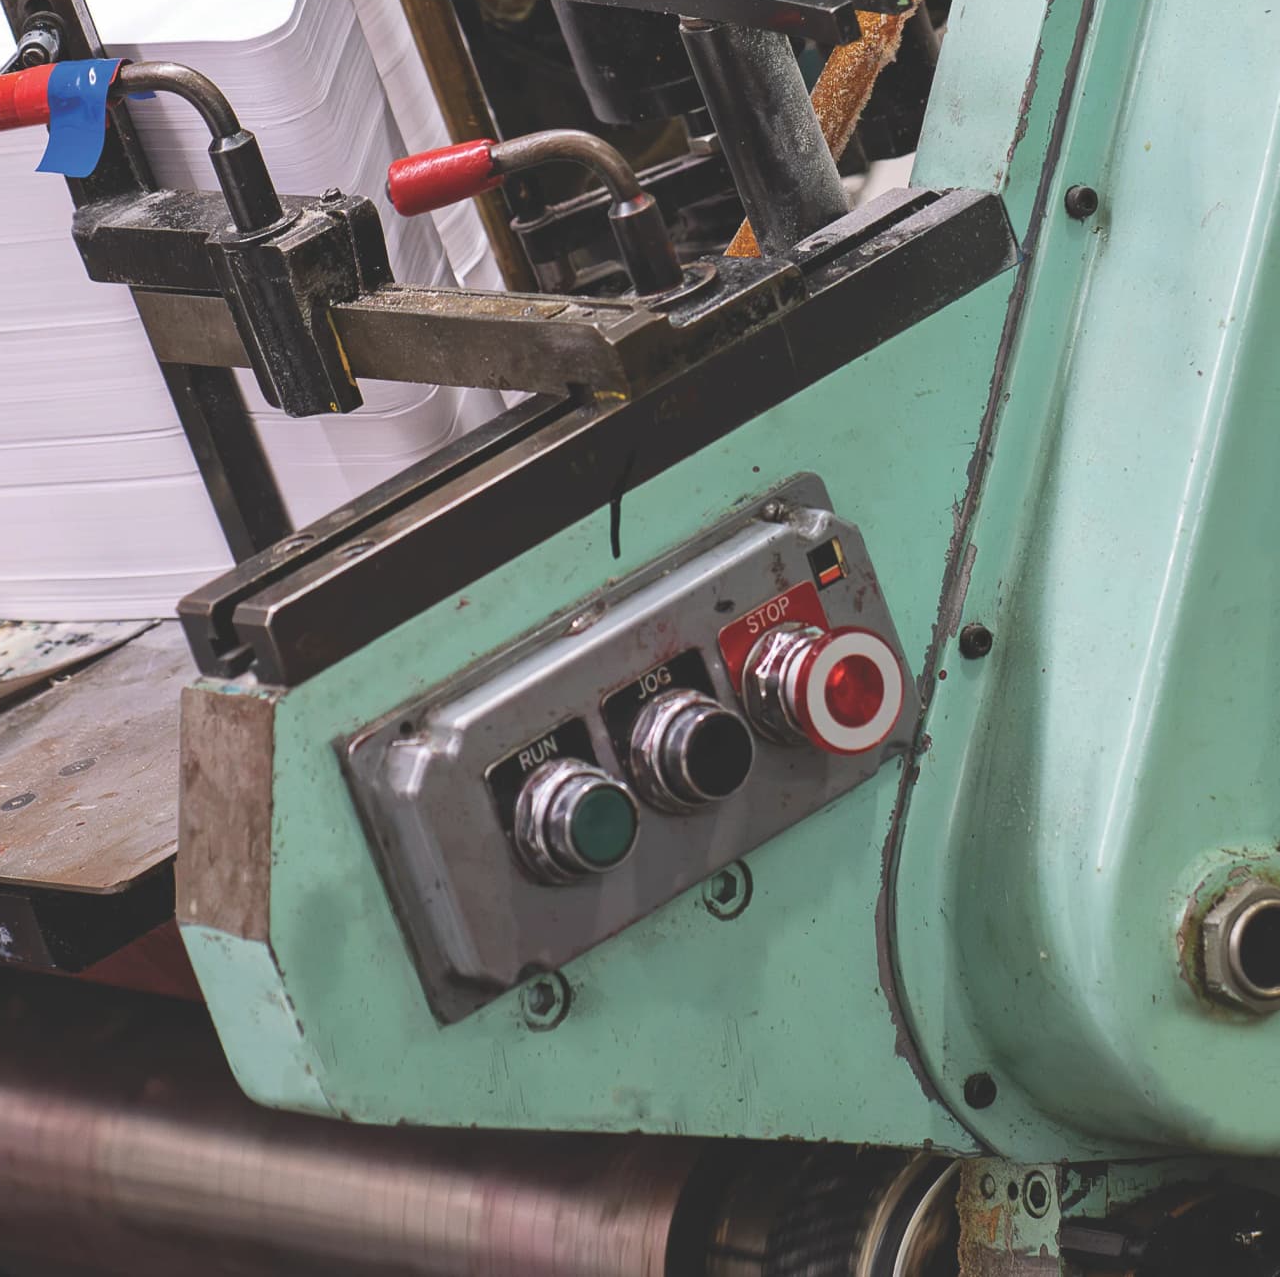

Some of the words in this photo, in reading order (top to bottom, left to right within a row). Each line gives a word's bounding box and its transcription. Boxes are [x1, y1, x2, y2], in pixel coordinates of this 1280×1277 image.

[746, 596, 790, 634] STOP
[638, 666, 672, 700] JOG
[519, 736, 559, 772] RUN
